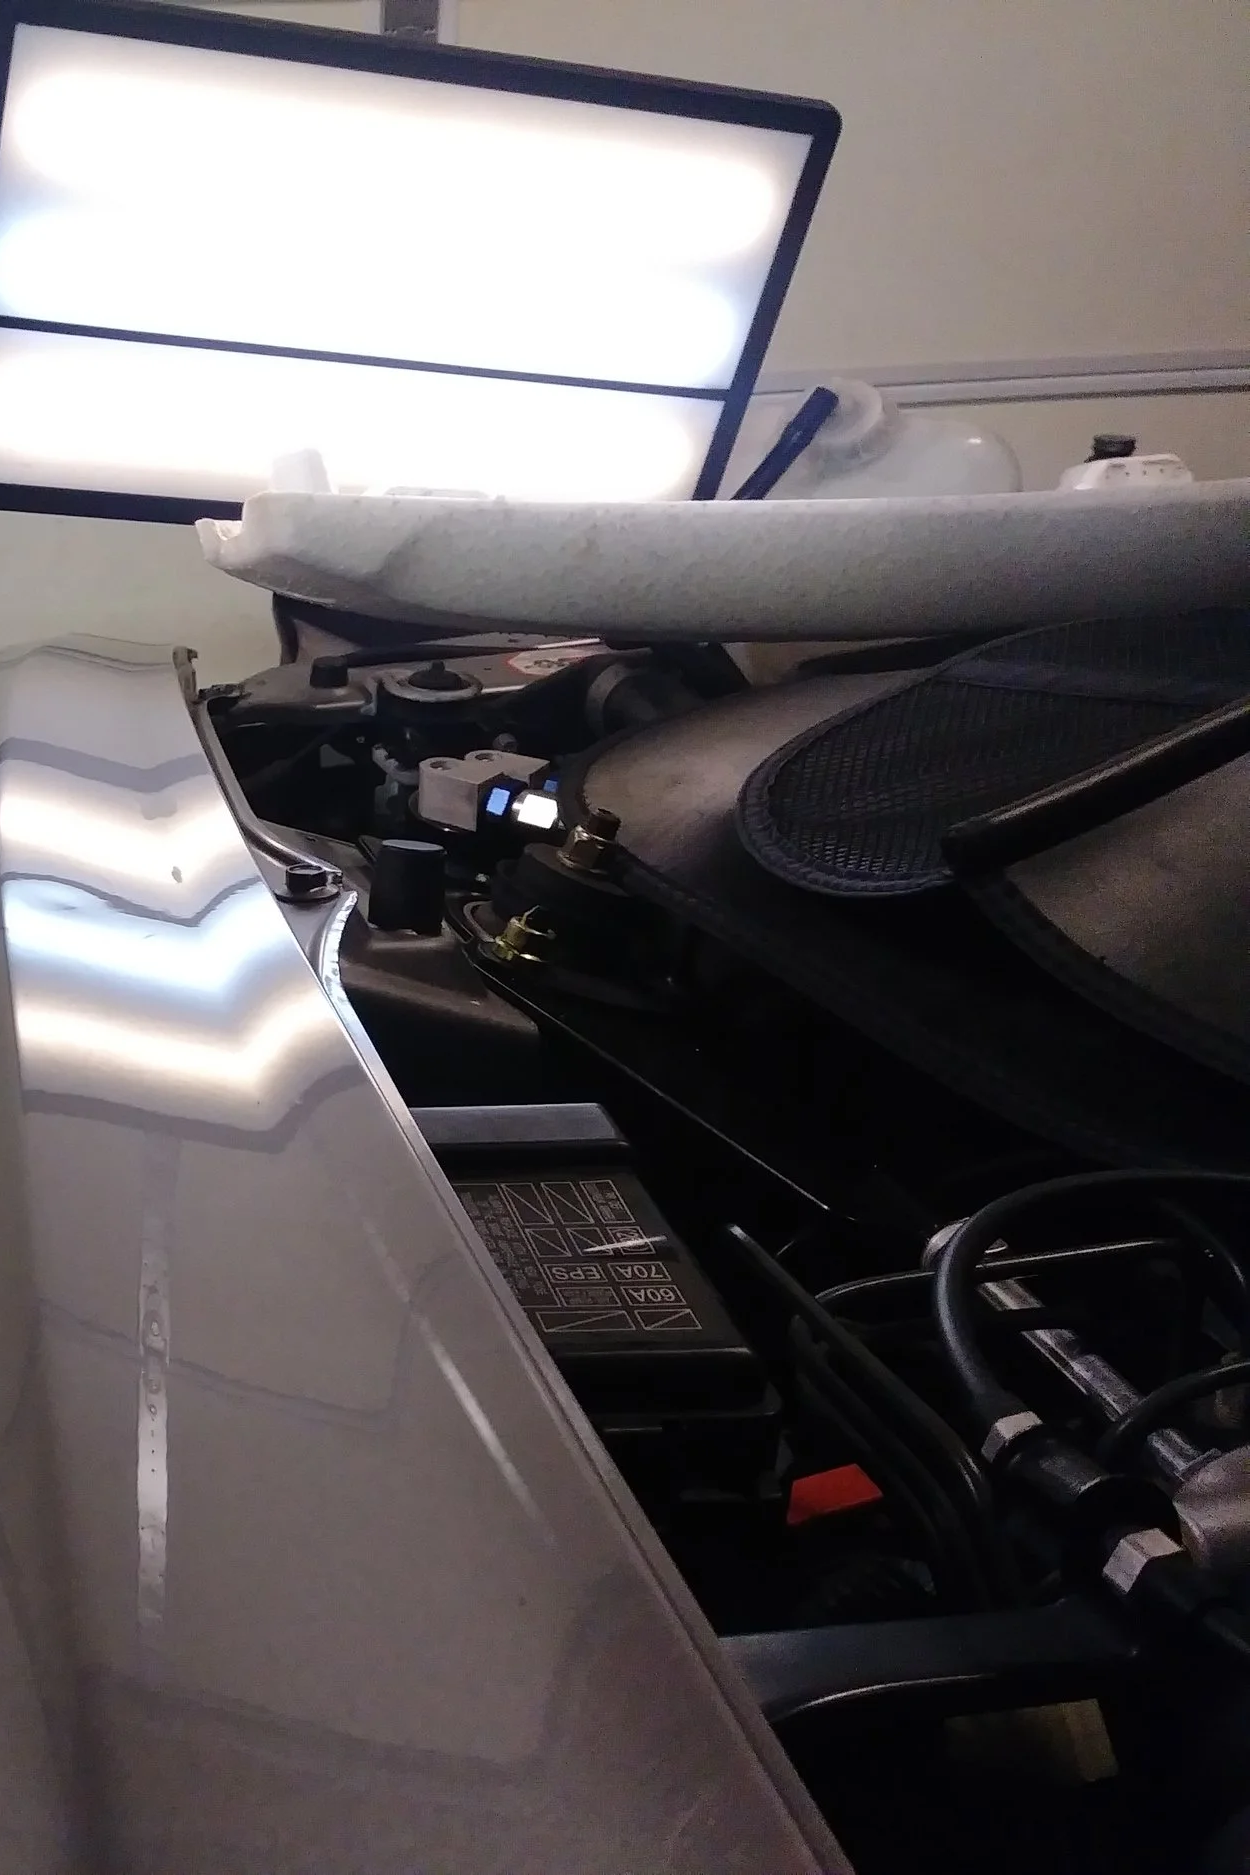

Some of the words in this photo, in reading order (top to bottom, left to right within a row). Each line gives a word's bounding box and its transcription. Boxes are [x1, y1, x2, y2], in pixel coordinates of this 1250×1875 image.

[551, 1265, 601, 1280] EPS
[615, 1263, 662, 1279] 70A
[627, 1287, 675, 1304] 60A
